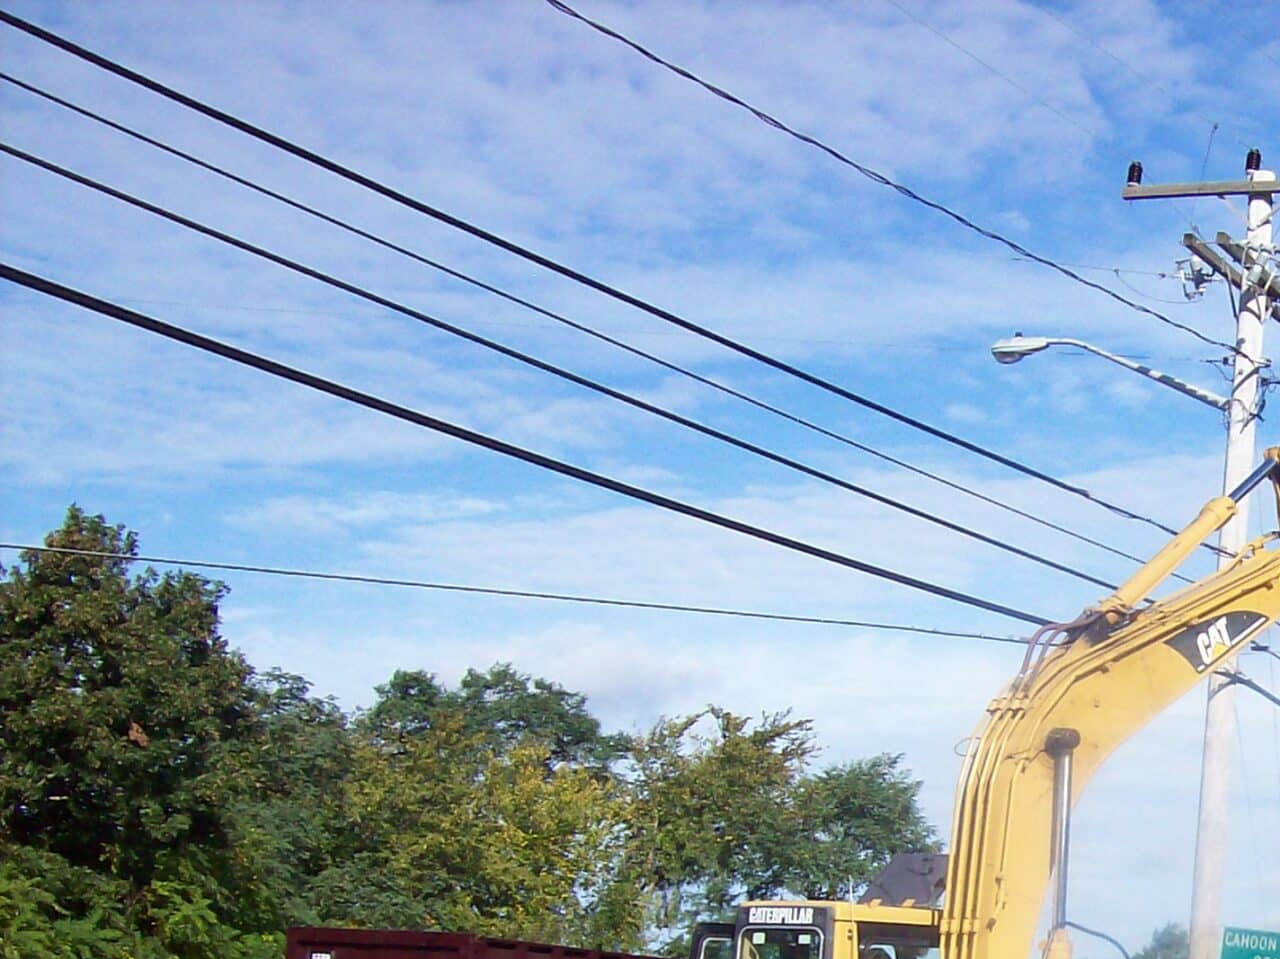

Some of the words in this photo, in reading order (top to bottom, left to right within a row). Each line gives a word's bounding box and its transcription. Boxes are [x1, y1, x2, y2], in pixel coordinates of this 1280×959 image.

[1197, 615, 1232, 665] CAT
[749, 907, 813, 924] CATERPILLAR
[1224, 931, 1276, 952] CAHOON
